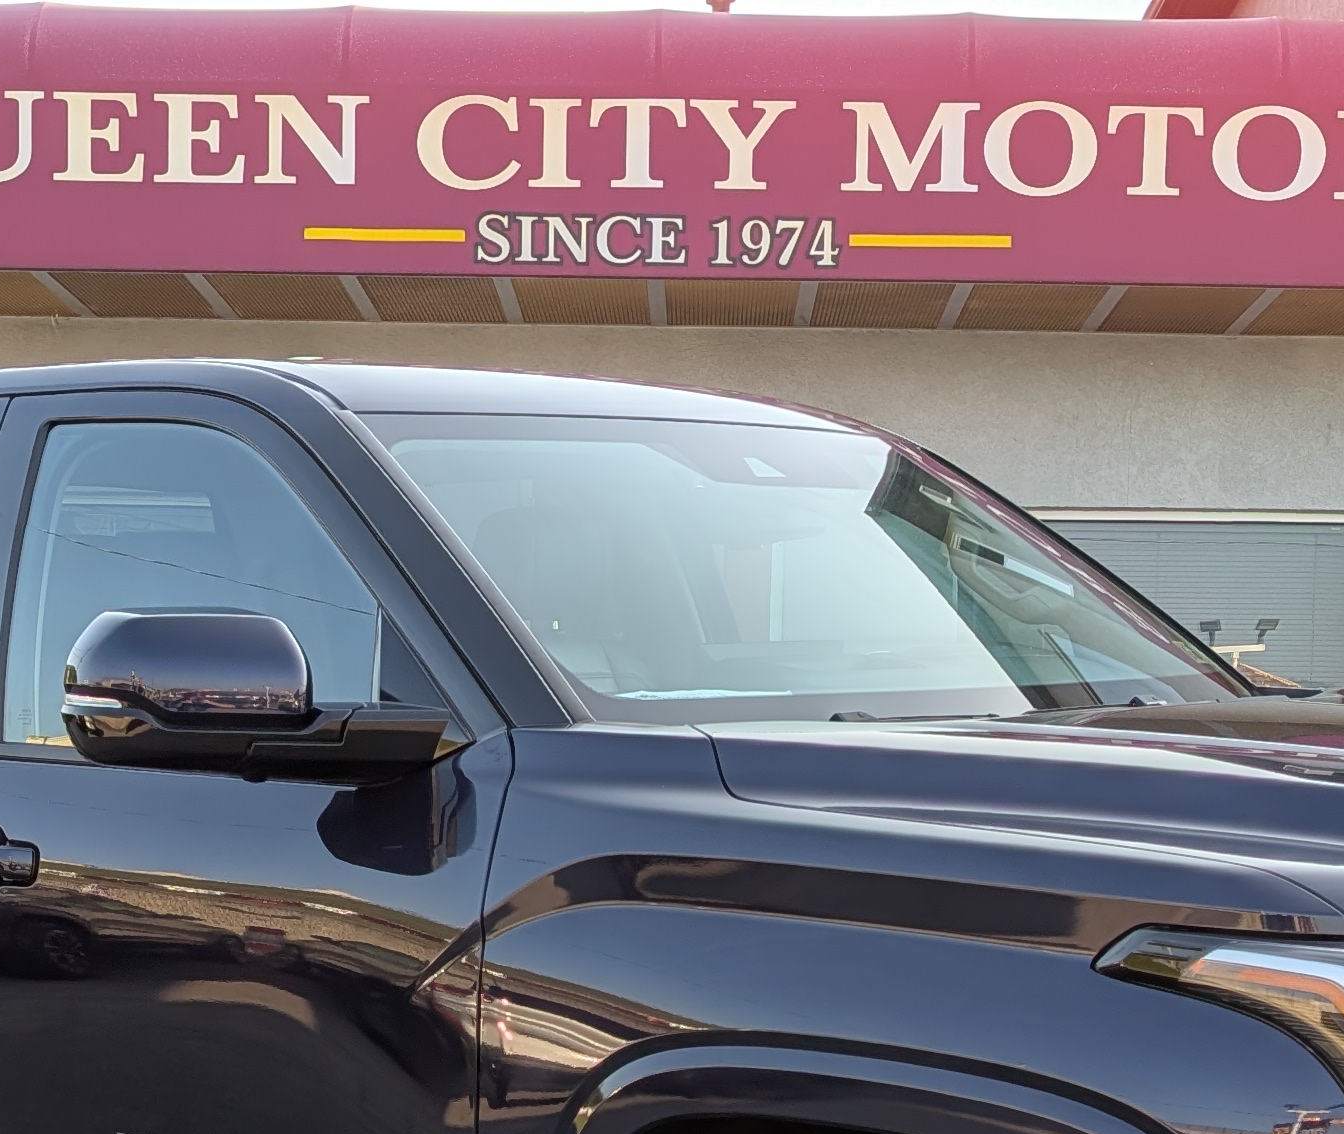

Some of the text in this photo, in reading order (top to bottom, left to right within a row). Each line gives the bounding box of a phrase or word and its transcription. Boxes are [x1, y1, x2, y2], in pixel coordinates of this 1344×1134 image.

[415, 94, 797, 192] CITY
[475, 212, 841, 268] SINCE 1974
